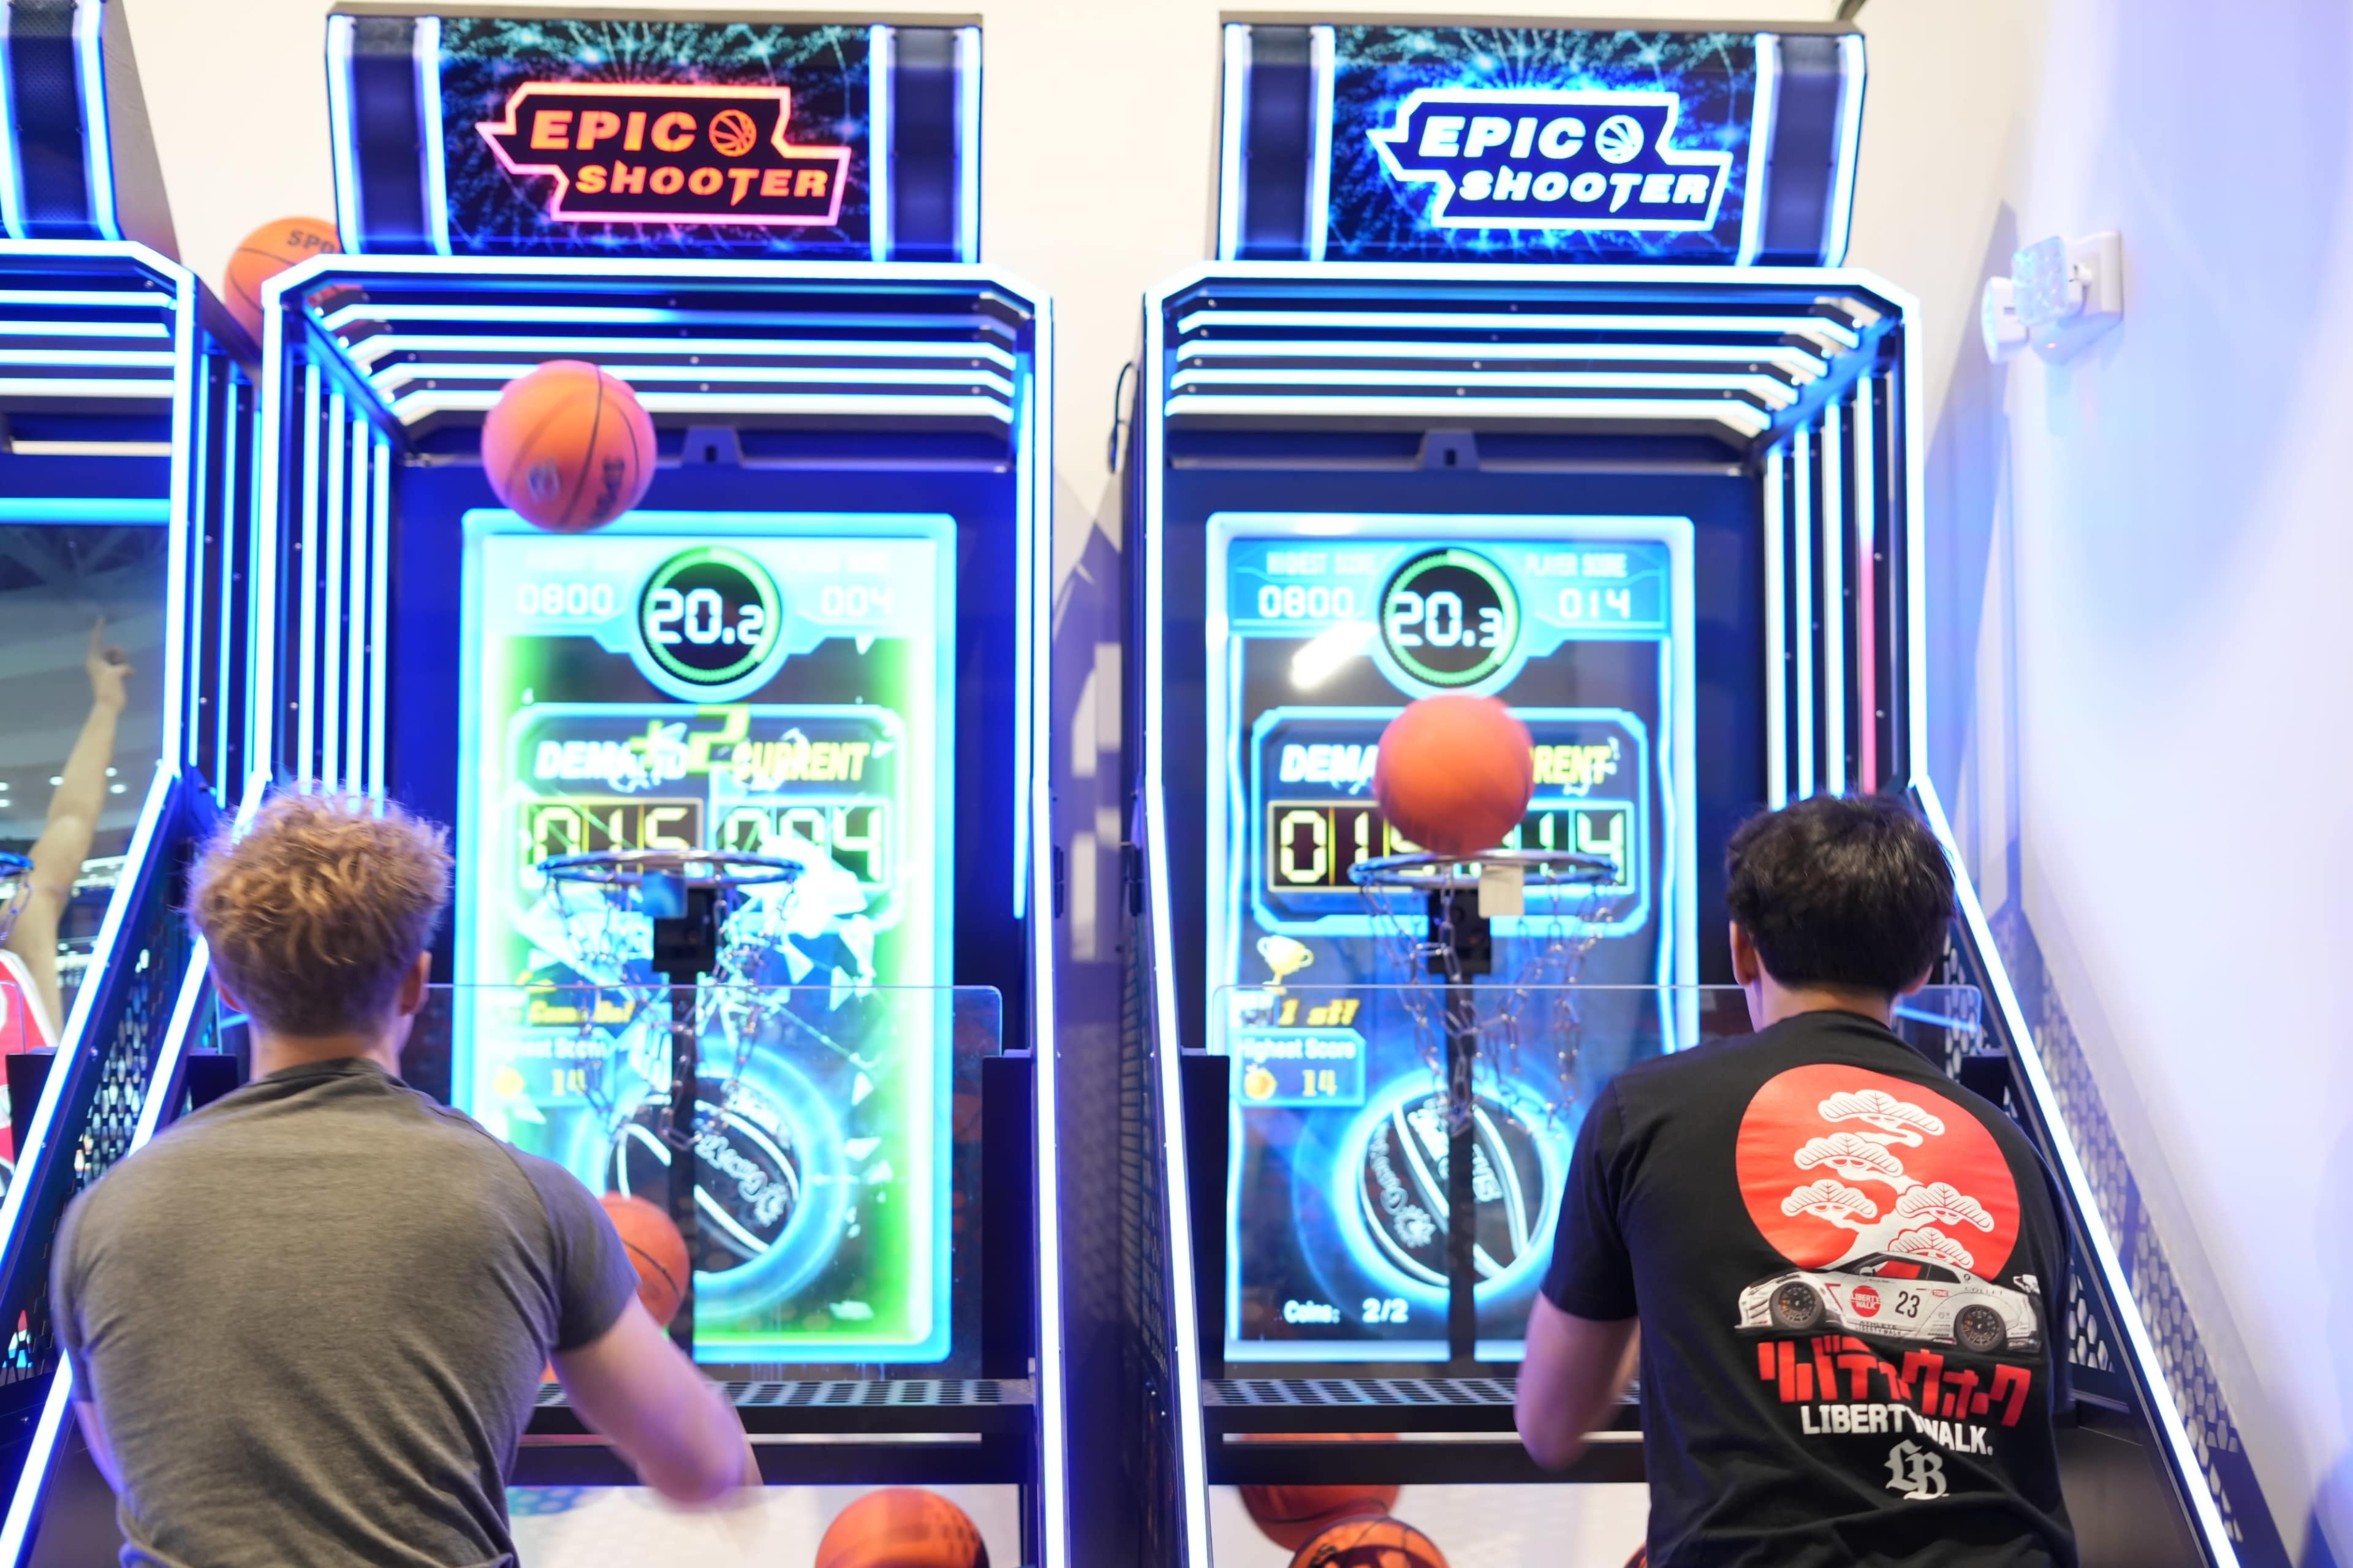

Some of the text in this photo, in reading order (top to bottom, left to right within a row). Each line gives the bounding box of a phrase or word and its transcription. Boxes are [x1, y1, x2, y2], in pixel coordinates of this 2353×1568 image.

[530, 110, 697, 152] EPIC
[1419, 115, 1586, 159] EPIC
[575, 160, 828, 206] SHOOTER
[1459, 165, 1710, 213] SHOOTER
[516, 581, 613, 615] 0800
[821, 585, 894, 618] 004
[1259, 585, 1354, 618] 0800
[1560, 588, 1631, 619] 014
[648, 588, 765, 644] 20.2
[1388, 591, 1503, 648] 20.3
[1303, 1069, 1338, 1097] 14
[1362, 1297, 1409, 1324] 2/2
[1851, 1293, 1881, 1304] LIBERTY
[1856, 1301, 1877, 1310] WALK
[1895, 1290, 1920, 1318] 23
